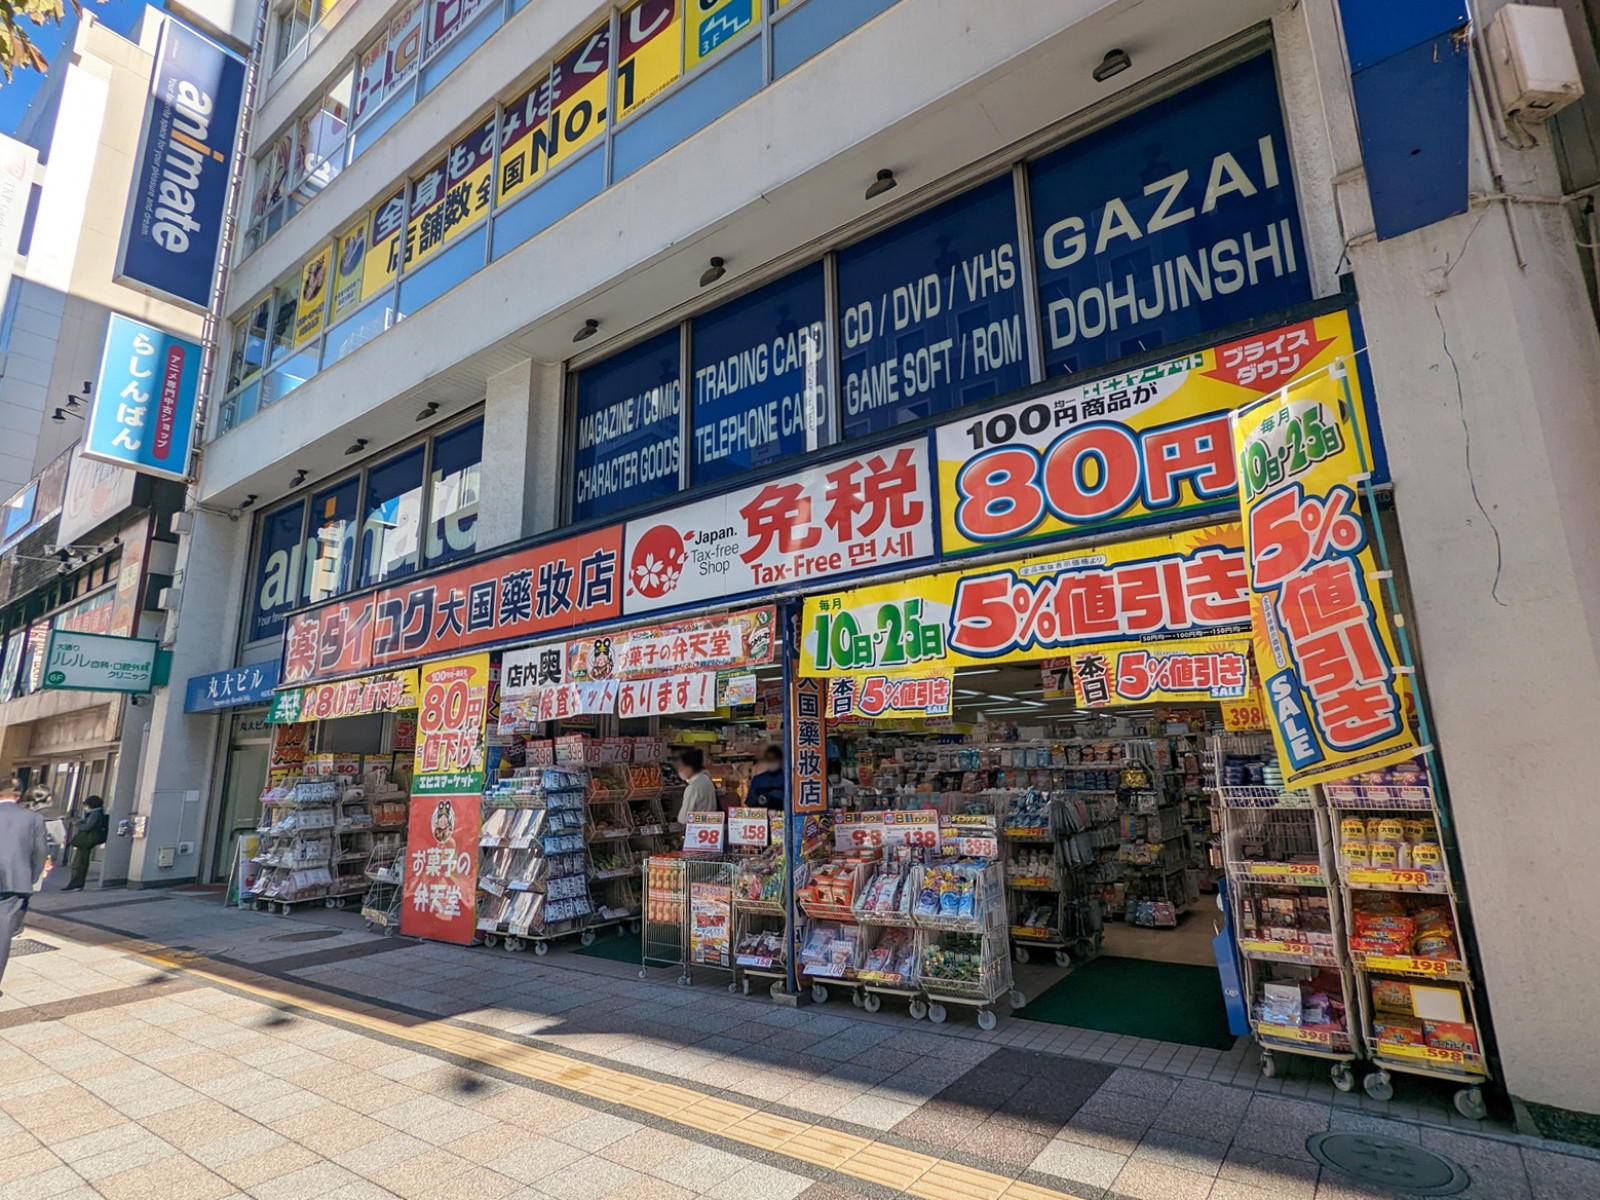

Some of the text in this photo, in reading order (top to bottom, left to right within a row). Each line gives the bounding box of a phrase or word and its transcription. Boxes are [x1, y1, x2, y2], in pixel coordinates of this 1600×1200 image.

[166, 76, 178, 93] Your
[152, 80, 225, 254] animate
[1043, 134, 1279, 269] GAZAI
[845, 243, 1016, 348] CD / DVD / VHS
[1048, 218, 1296, 350] DOHJINSHI
[696, 343, 768, 405] TRADING
[773, 321, 824, 376] CARD
[847, 358, 899, 415] GAME
[903, 338, 953, 397] SOFT
[960, 333, 966, 380] /
[972, 314, 1022, 375] ROM
[1223, 328, 1310, 368] プライス
[1236, 352, 1301, 385] ダウン
[112, 332, 155, 451] らしんばん
[579, 397, 634, 450] MAGAZINE
[643, 379, 680, 426] COMIC
[1261, 407, 1291, 434] 毎月
[695, 401, 778, 464] TELEPHONE
[577, 436, 680, 503] CHARACTER GOODS
[956, 409, 1238, 542] 80円
[739, 447, 924, 565] 免税
[694, 525, 738, 546] Japan.
[848, 531, 914, 567] 면세
[691, 543, 740, 564] Tax-free
[699, 559, 731, 576] Shop
[751, 551, 842, 586] Tax-Free
[819, 599, 842, 611] 毎月
[952, 553, 1250, 652] 5%値引き
[618, 630, 731, 668] お菓子の弁天堂
[108, 671, 148, 681] クリニック
[207, 669, 264, 700] 丸大ビル
[507, 649, 562, 688] 店内奥
[1076, 655, 1109, 706] 本日
[1117, 651, 1244, 698] 5%値引き
[420, 679, 485, 733] 80円
[832, 679, 854, 715] 本日
[860, 677, 950, 713] 5%値引き
[1211, 687, 1242, 697] SALE
[926, 706, 948, 714] SALE
[1229, 706, 1261, 727] 398
[1271, 675, 1315, 760] SALE
[698, 829, 719, 844] 98
[742, 825, 766, 839] 158
[904, 830, 937, 848] 138
[412, 848, 471, 877] お菓子の
[1289, 865, 1319, 874] 298
[1392, 872, 1425, 883] 798
[413, 882, 462, 916] 弁天堂
[1283, 944, 1312, 954] 398
[1411, 959, 1446, 972] 198
[1299, 1031, 1329, 1042] 398
[1427, 1049, 1462, 1061] 598
